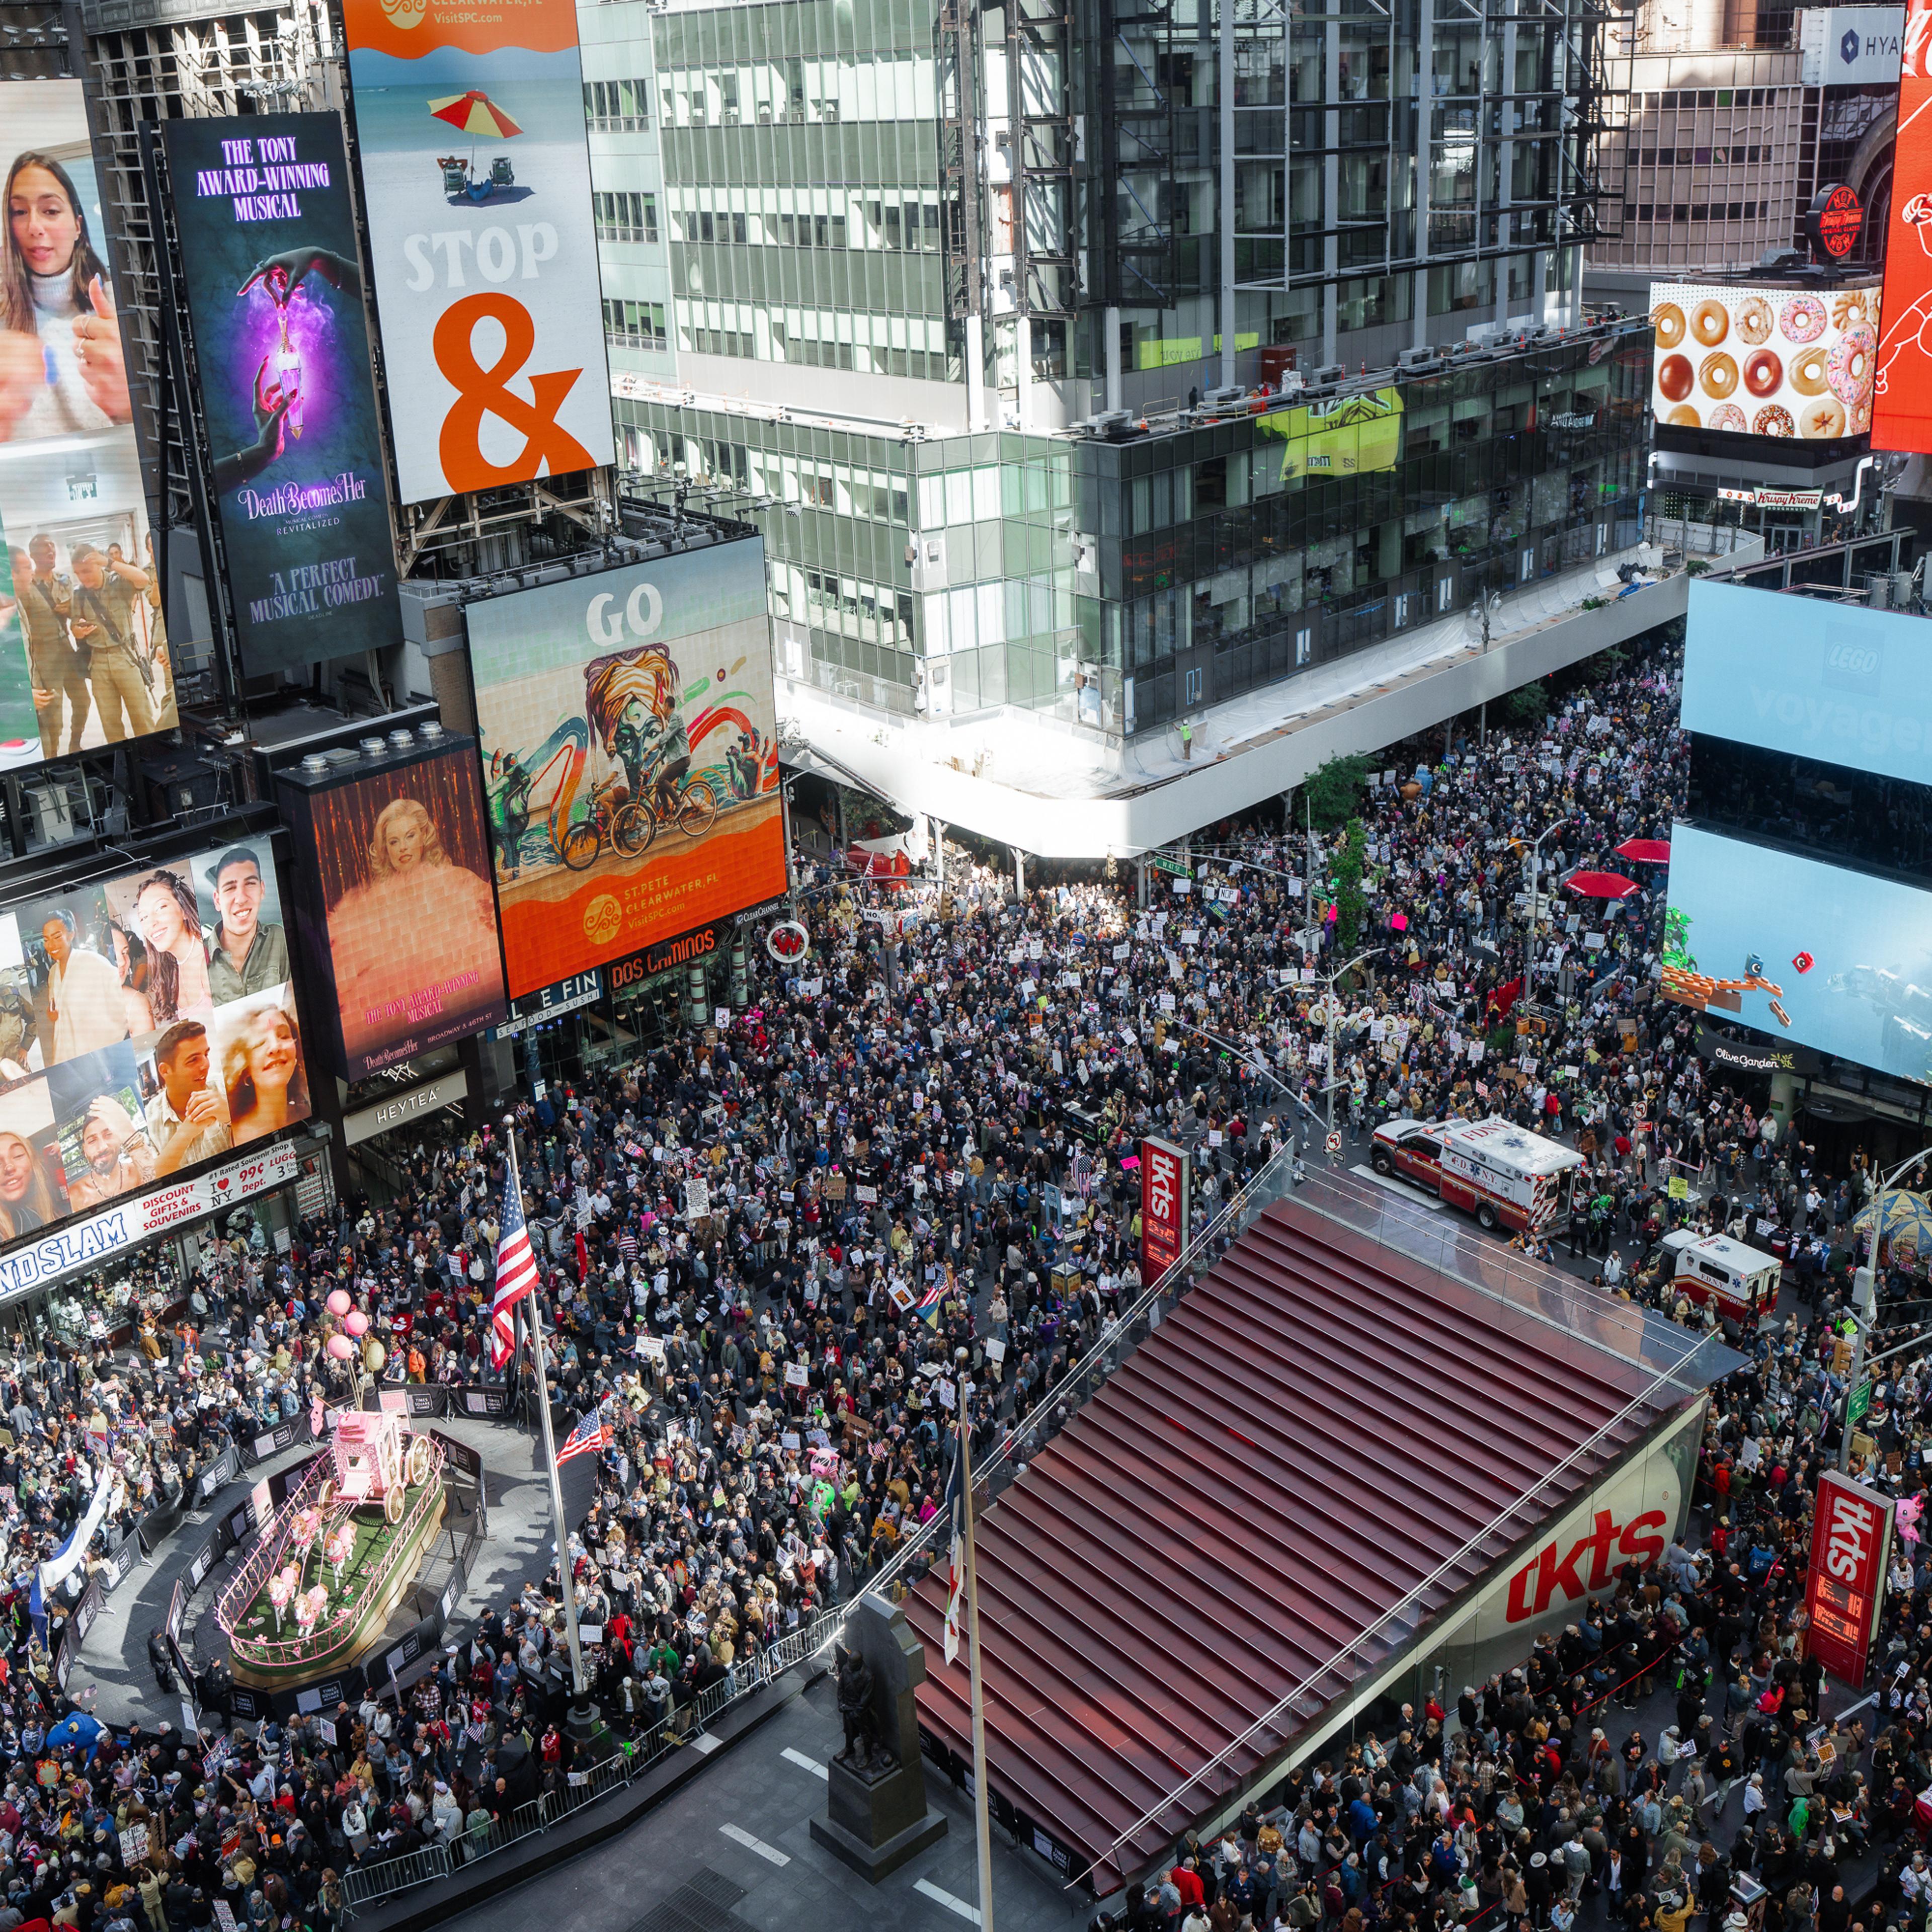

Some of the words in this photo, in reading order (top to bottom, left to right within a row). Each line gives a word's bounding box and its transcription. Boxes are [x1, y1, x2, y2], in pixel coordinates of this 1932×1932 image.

[434, 12, 502, 24] VisitSPC.com
[1866, 36, 1903, 55] HYA
[221, 139, 254, 165] THE
[258, 137, 296, 163] TONY
[233, 193, 301, 222] MUSICAL
[1833, 192, 1853, 207] HOT
[1829, 234, 1850, 251] NOW
[404, 222, 559, 292] STOP
[433, 292, 585, 483] &
[237, 488, 286, 520] Death
[283, 482, 343, 515] Becomes
[335, 472, 366, 502] Her
[1757, 492, 1789, 505] Krispy
[1788, 493, 1819, 505] Kreme
[276, 517, 340, 536] REVITALIZED
[289, 557, 356, 591] PERFECT
[250, 589, 319, 624] MUSICAL
[587, 583, 663, 647] GO
[1827, 642, 1879, 674] LEGO
[628, 903, 685, 929] VisitSPC.com
[775, 933, 802, 955] W
[612, 958, 643, 988] DOS
[366, 1008, 382, 1024] THE
[384, 998, 406, 1017] TONY
[409, 971, 478, 1008] AWARD-WINNING
[498, 988, 552, 1026] LE
[562, 971, 597, 1000] FIN
[407, 1000, 443, 1024] MUSICAL
[499, 1010, 551, 1036] SEAFOOD
[566, 991, 598, 1009] SUSHI
[427, 1025, 460, 1043] BROADWAY
[486, 1012, 493, 1020] ST
[363, 1055, 384, 1070] Death
[383, 1047, 408, 1063] Becomes
[405, 1039, 418, 1053] Her
[1716, 1048, 1739, 1063] Olive
[1739, 1055, 1780, 1069] Garden
[1461, 1120, 1511, 1141] FDNY
[208, 1172, 217, 1180] #1
[219, 1164, 240, 1178] Rated
[241, 1150, 270, 1167] Souvenir
[272, 1143, 289, 1155] Shop
[239, 1162, 264, 1182] 99¢
[270, 1151, 296, 1167] LUGG
[278, 1166, 285, 1178] 3
[142, 1184, 195, 1210] DISCOUNT
[210, 1182, 218, 1194] I
[210, 1189, 234, 1208] NY
[242, 1179, 266, 1193] Dept.
[1152, 1153, 1175, 1220] tkts
[143, 1203, 201, 1231] SOUVENIRS
[150, 1201, 179, 1217] GIFTS
[181, 1197, 188, 1206] &
[38, 1213, 128, 1274] SLAM
[1699, 1238, 1720, 1248] FDNY
[1727, 1296, 1740, 1306] FDNY
[1827, 1496, 1873, 1583] tkts
[1506, 1509, 1667, 1624] tkts
[322, 1689, 339, 1698] SQUARE
[1053, 1852, 1067, 1866] SQUARE
[1055, 1847, 1067, 1860] TIMES
